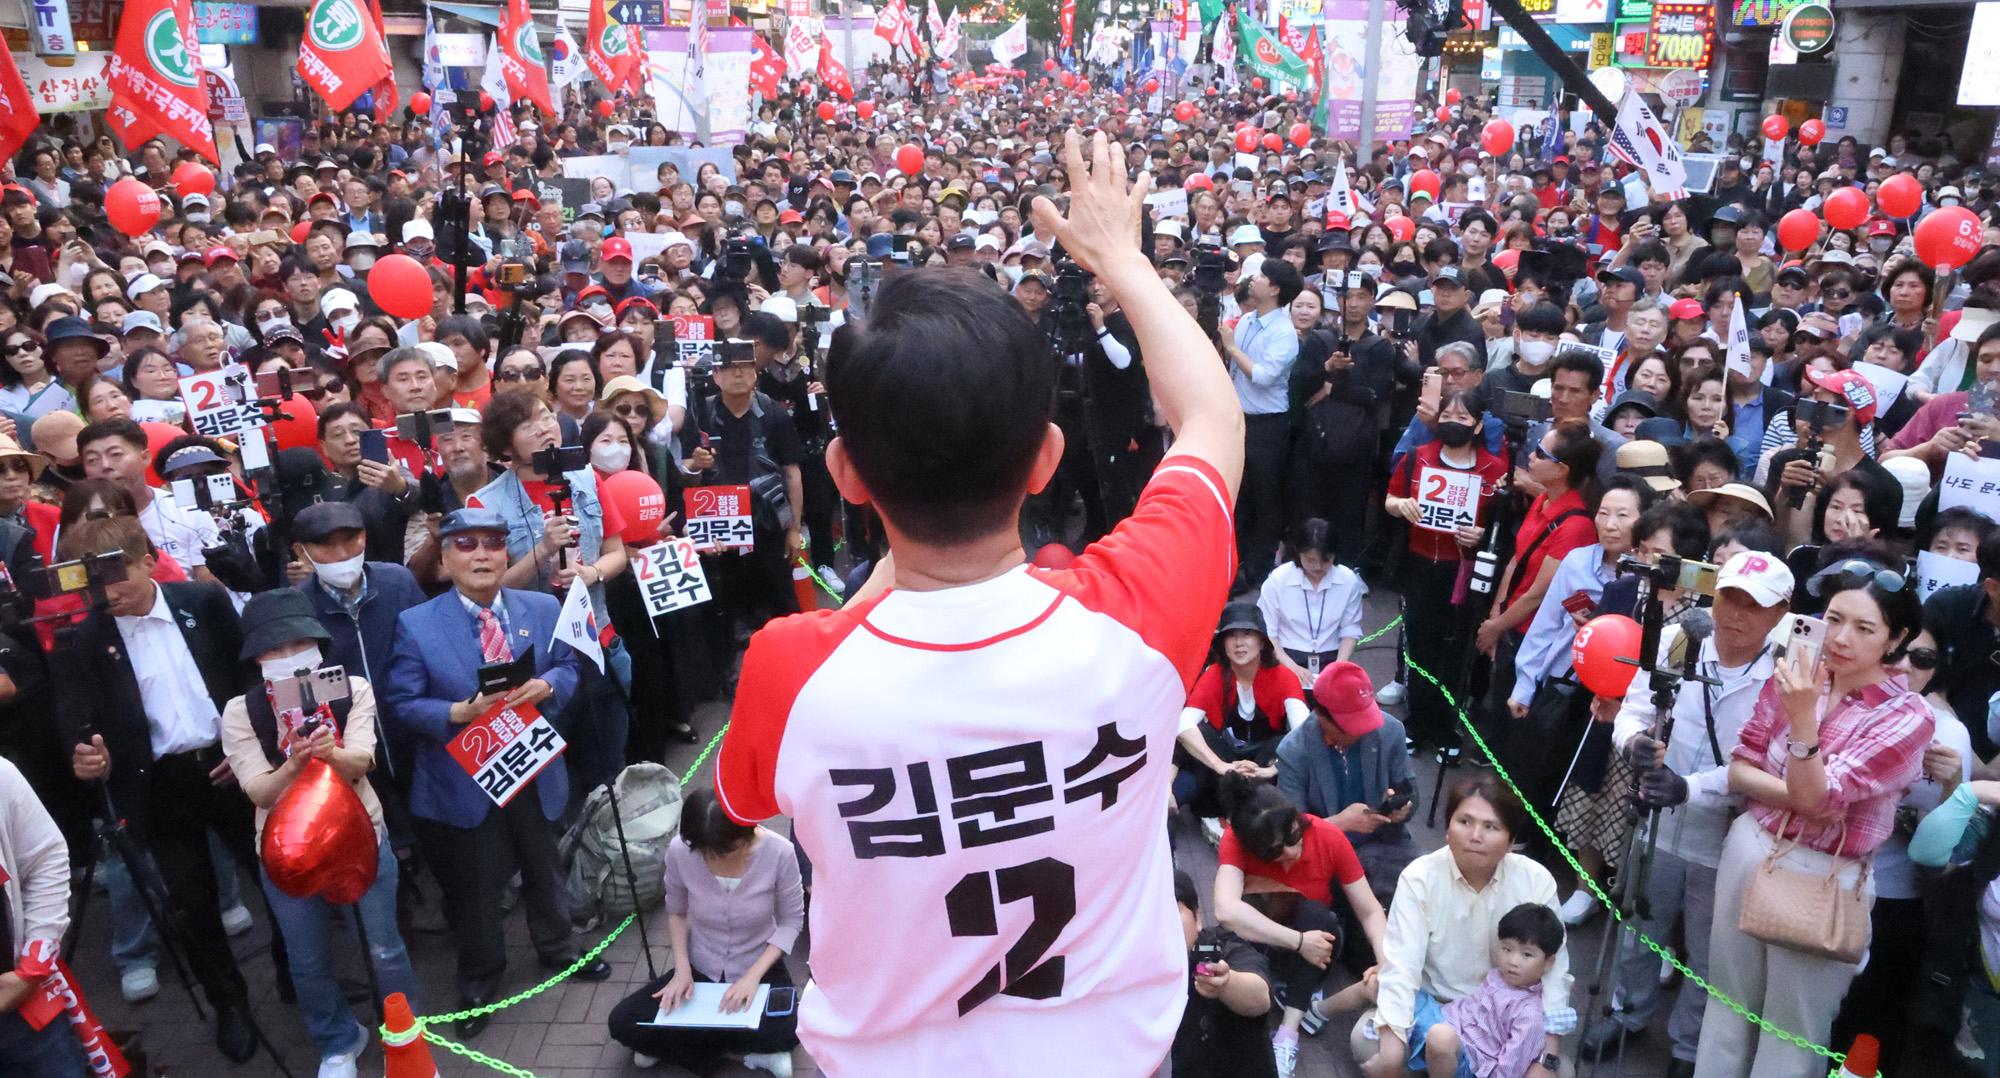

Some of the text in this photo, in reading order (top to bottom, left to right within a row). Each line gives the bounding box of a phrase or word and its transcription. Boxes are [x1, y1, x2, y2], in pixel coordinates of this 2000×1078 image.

[1658, 14, 1695, 32] 콘서트
[1656, 34, 1705, 61] 7080
[1959, 219, 1984, 243] 6.3
[191, 380, 221, 412] 2
[194, 406, 264, 435] 김문수
[1425, 474, 1448, 503] 2
[1945, 475, 1974, 490] 나도
[638, 507, 664, 521] 김문수
[693, 489, 717, 518] 2
[1419, 503, 1474, 529] 김문수
[688, 519, 753, 544] 김문수
[633, 553, 655, 581] 2
[677, 542, 698, 569] 2
[1737, 556, 1769, 576] P
[647, 572, 704, 611] 문수
[462, 726, 503, 767] 2
[478, 725, 558, 800] 김문수
[829, 721, 1148, 860] 김문수
[944, 856, 1077, 1018] 2
